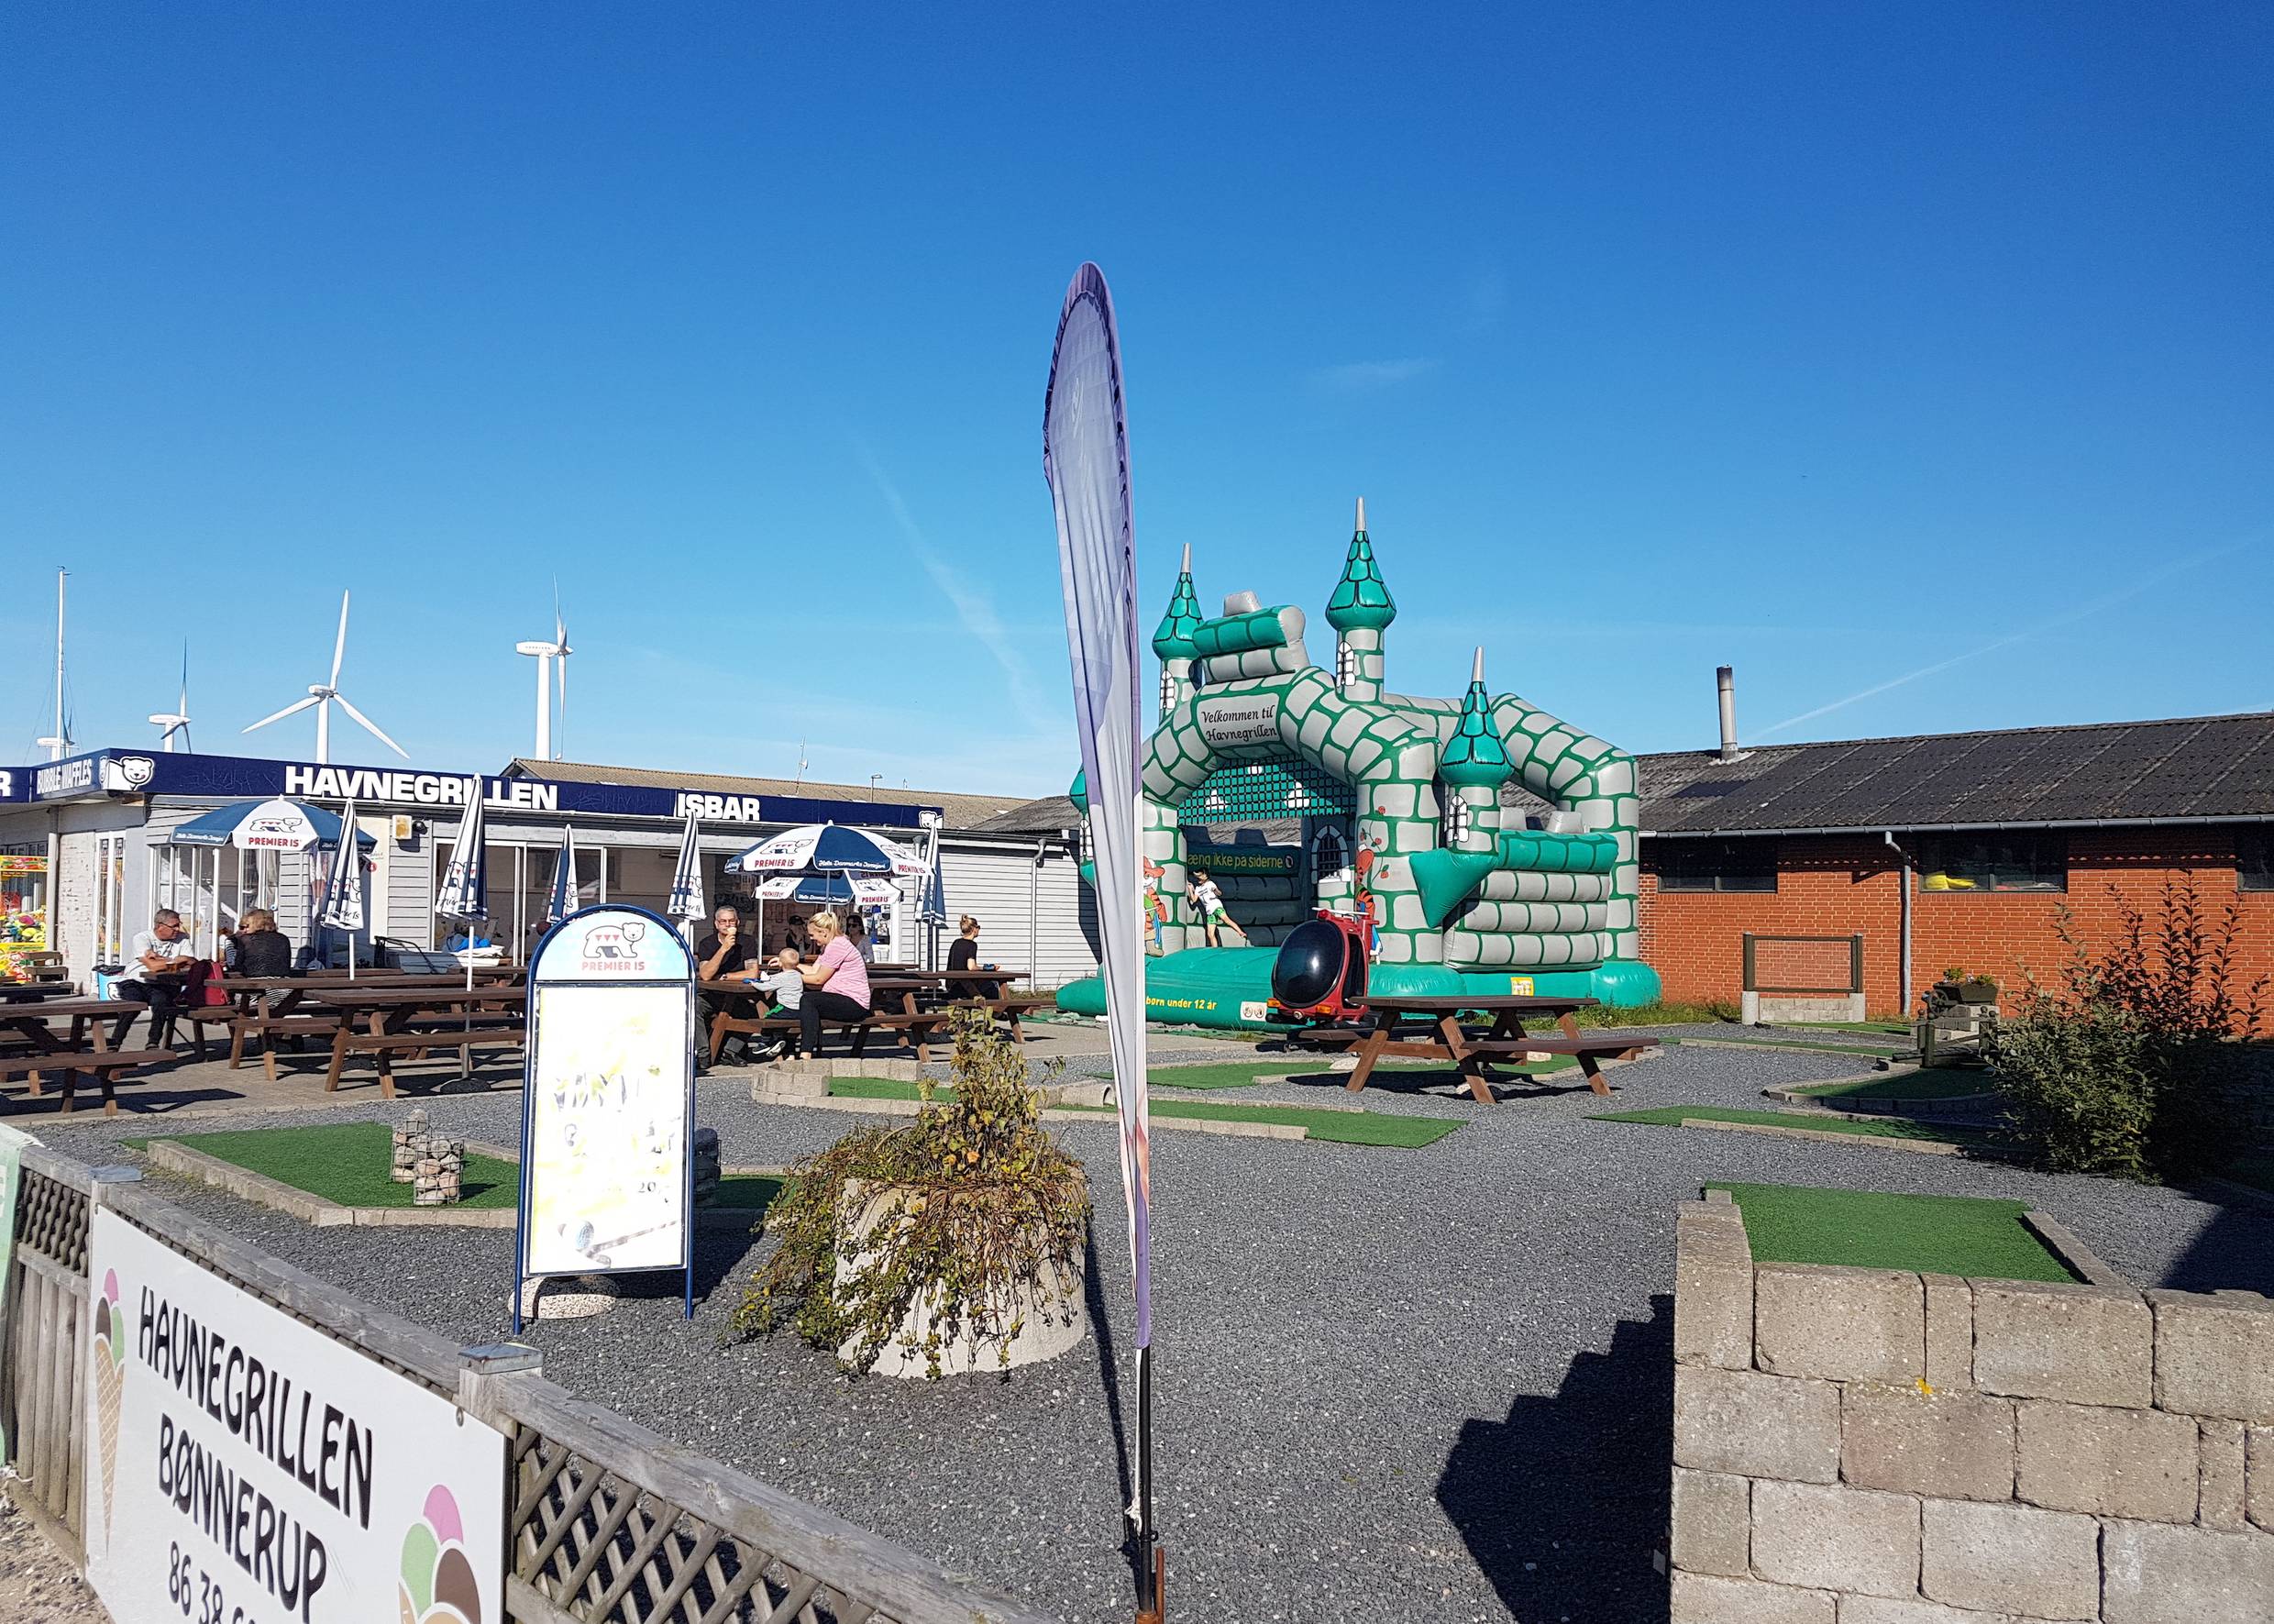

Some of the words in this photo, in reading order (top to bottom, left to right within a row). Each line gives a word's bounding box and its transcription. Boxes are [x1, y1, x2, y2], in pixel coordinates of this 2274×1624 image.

[1201, 709, 1259, 724] Velkommen
[1262, 704, 1275, 719] til
[1206, 724, 1277, 742] Havnegrillen
[37, 765, 62, 794] BUBBLE
[62, 758, 92, 789] WAFFLES
[285, 765, 557, 811] HAVNEGRILEN
[678, 792, 760, 822] ISBAR
[248, 836, 289, 846] PREMIER
[290, 838, 300, 847] IS
[755, 858, 787, 868] PREMIER
[787, 858, 795, 867] IS
[1187, 854, 1210, 867] æng
[1213, 852, 1233, 867] ikke
[1248, 854, 1284, 868] siderne
[581, 961, 631, 971] PREMIER
[635, 961, 646, 971] IS
[1167, 998, 1192, 1009] under
[1194, 999, 1206, 1010] 12
[138, 1285, 372, 1531] HAVNEGRILLEN
[159, 1412, 327, 1624] BØNNERUP
[169, 1541, 192, 1617] 86
